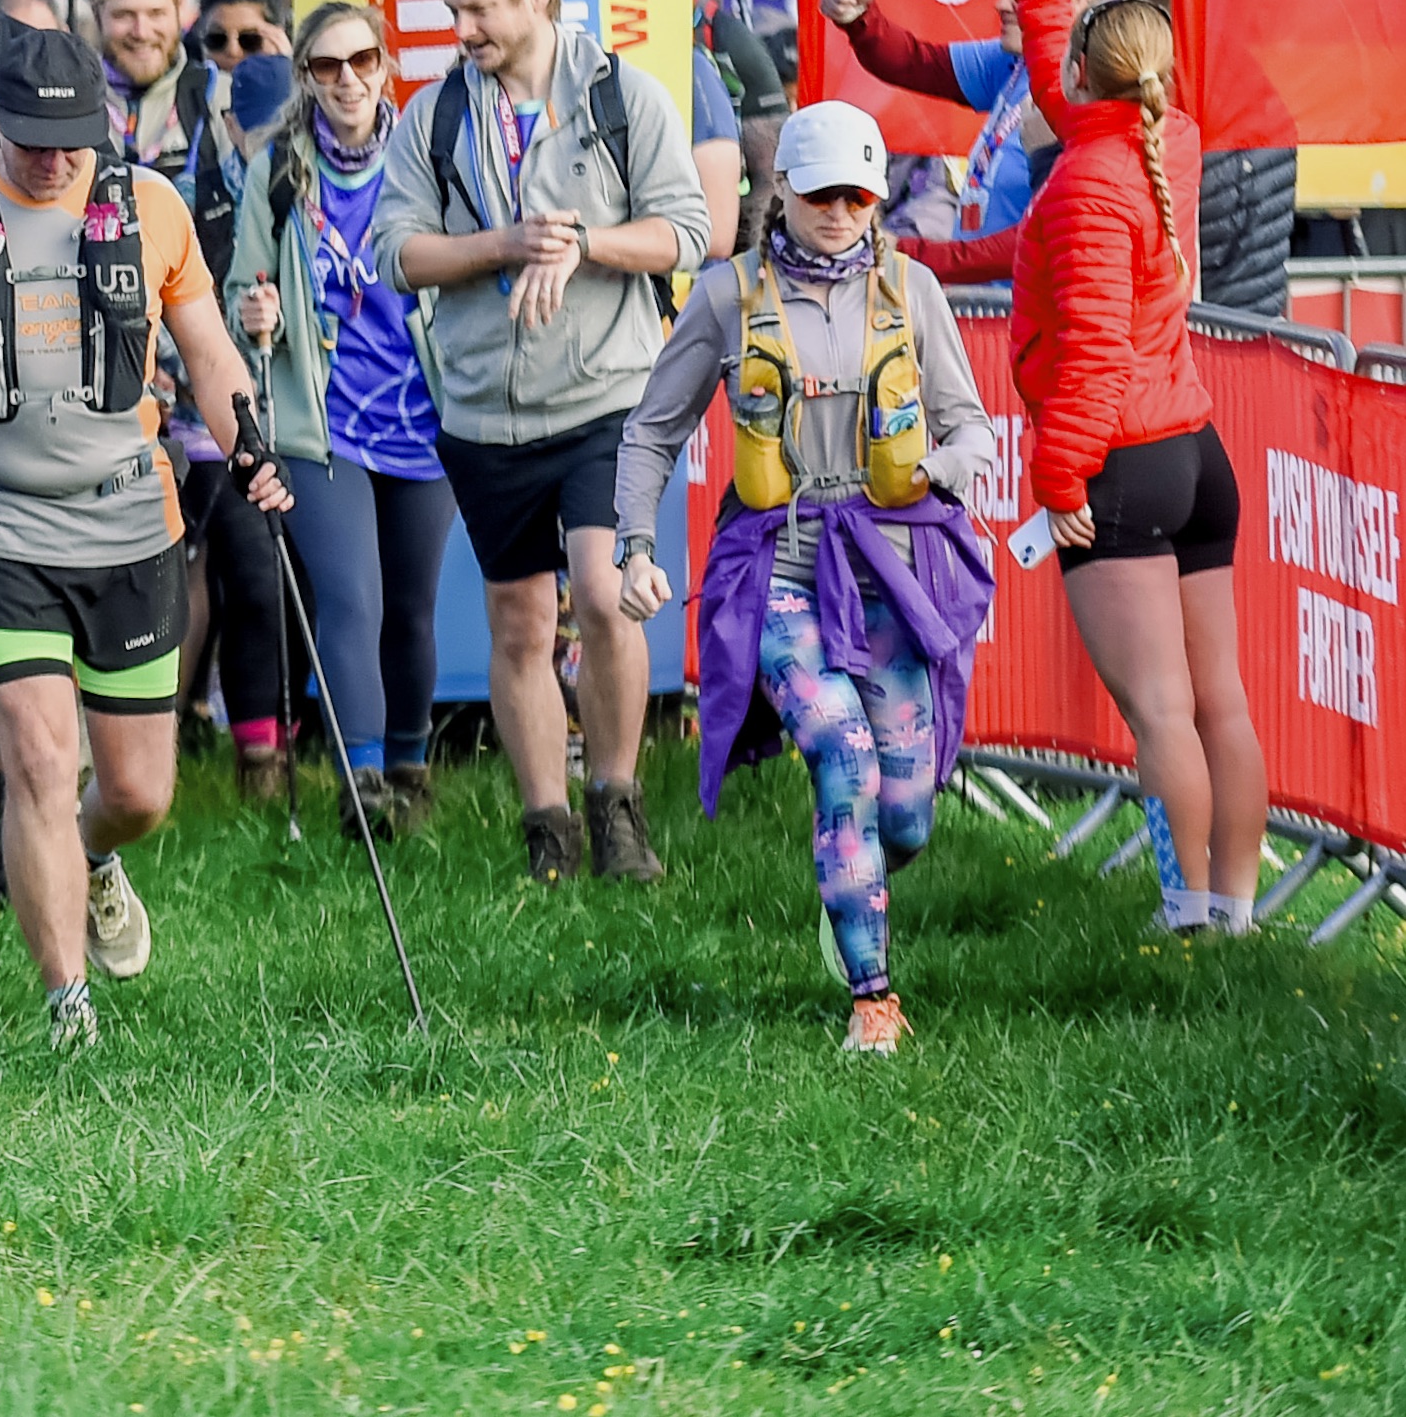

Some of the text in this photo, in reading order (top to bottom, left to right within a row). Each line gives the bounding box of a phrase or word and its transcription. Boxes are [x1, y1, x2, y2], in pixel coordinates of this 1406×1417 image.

[1265, 447, 1401, 607] PUSH YOURSELF
[1297, 586, 1378, 730] FURTHER
